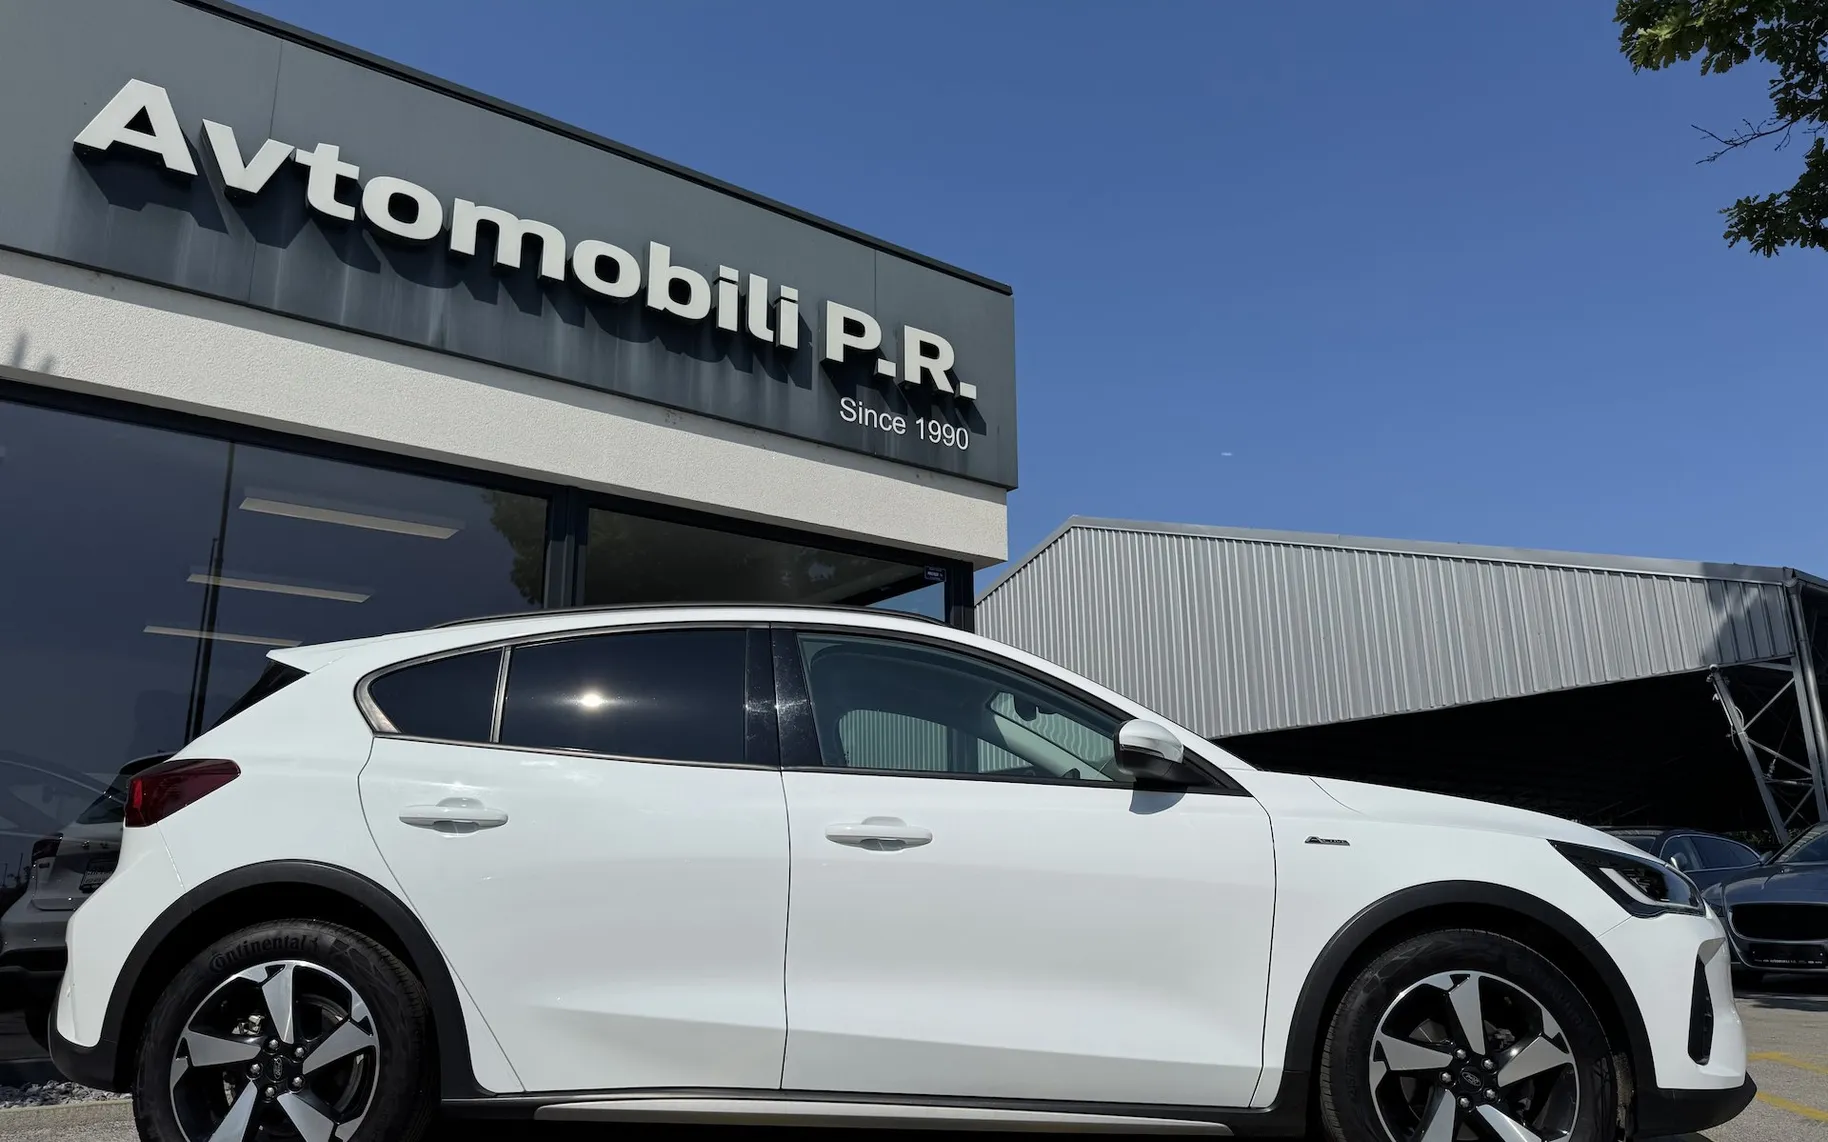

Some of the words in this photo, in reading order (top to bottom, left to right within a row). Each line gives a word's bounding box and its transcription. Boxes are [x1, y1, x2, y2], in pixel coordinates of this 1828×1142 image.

[74, 78, 799, 349] Avtomobili
[825, 300, 977, 400] P.R.
[840, 397, 906, 435] Since
[915, 417, 969, 450] 1990
[209, 935, 307, 972] Continental
